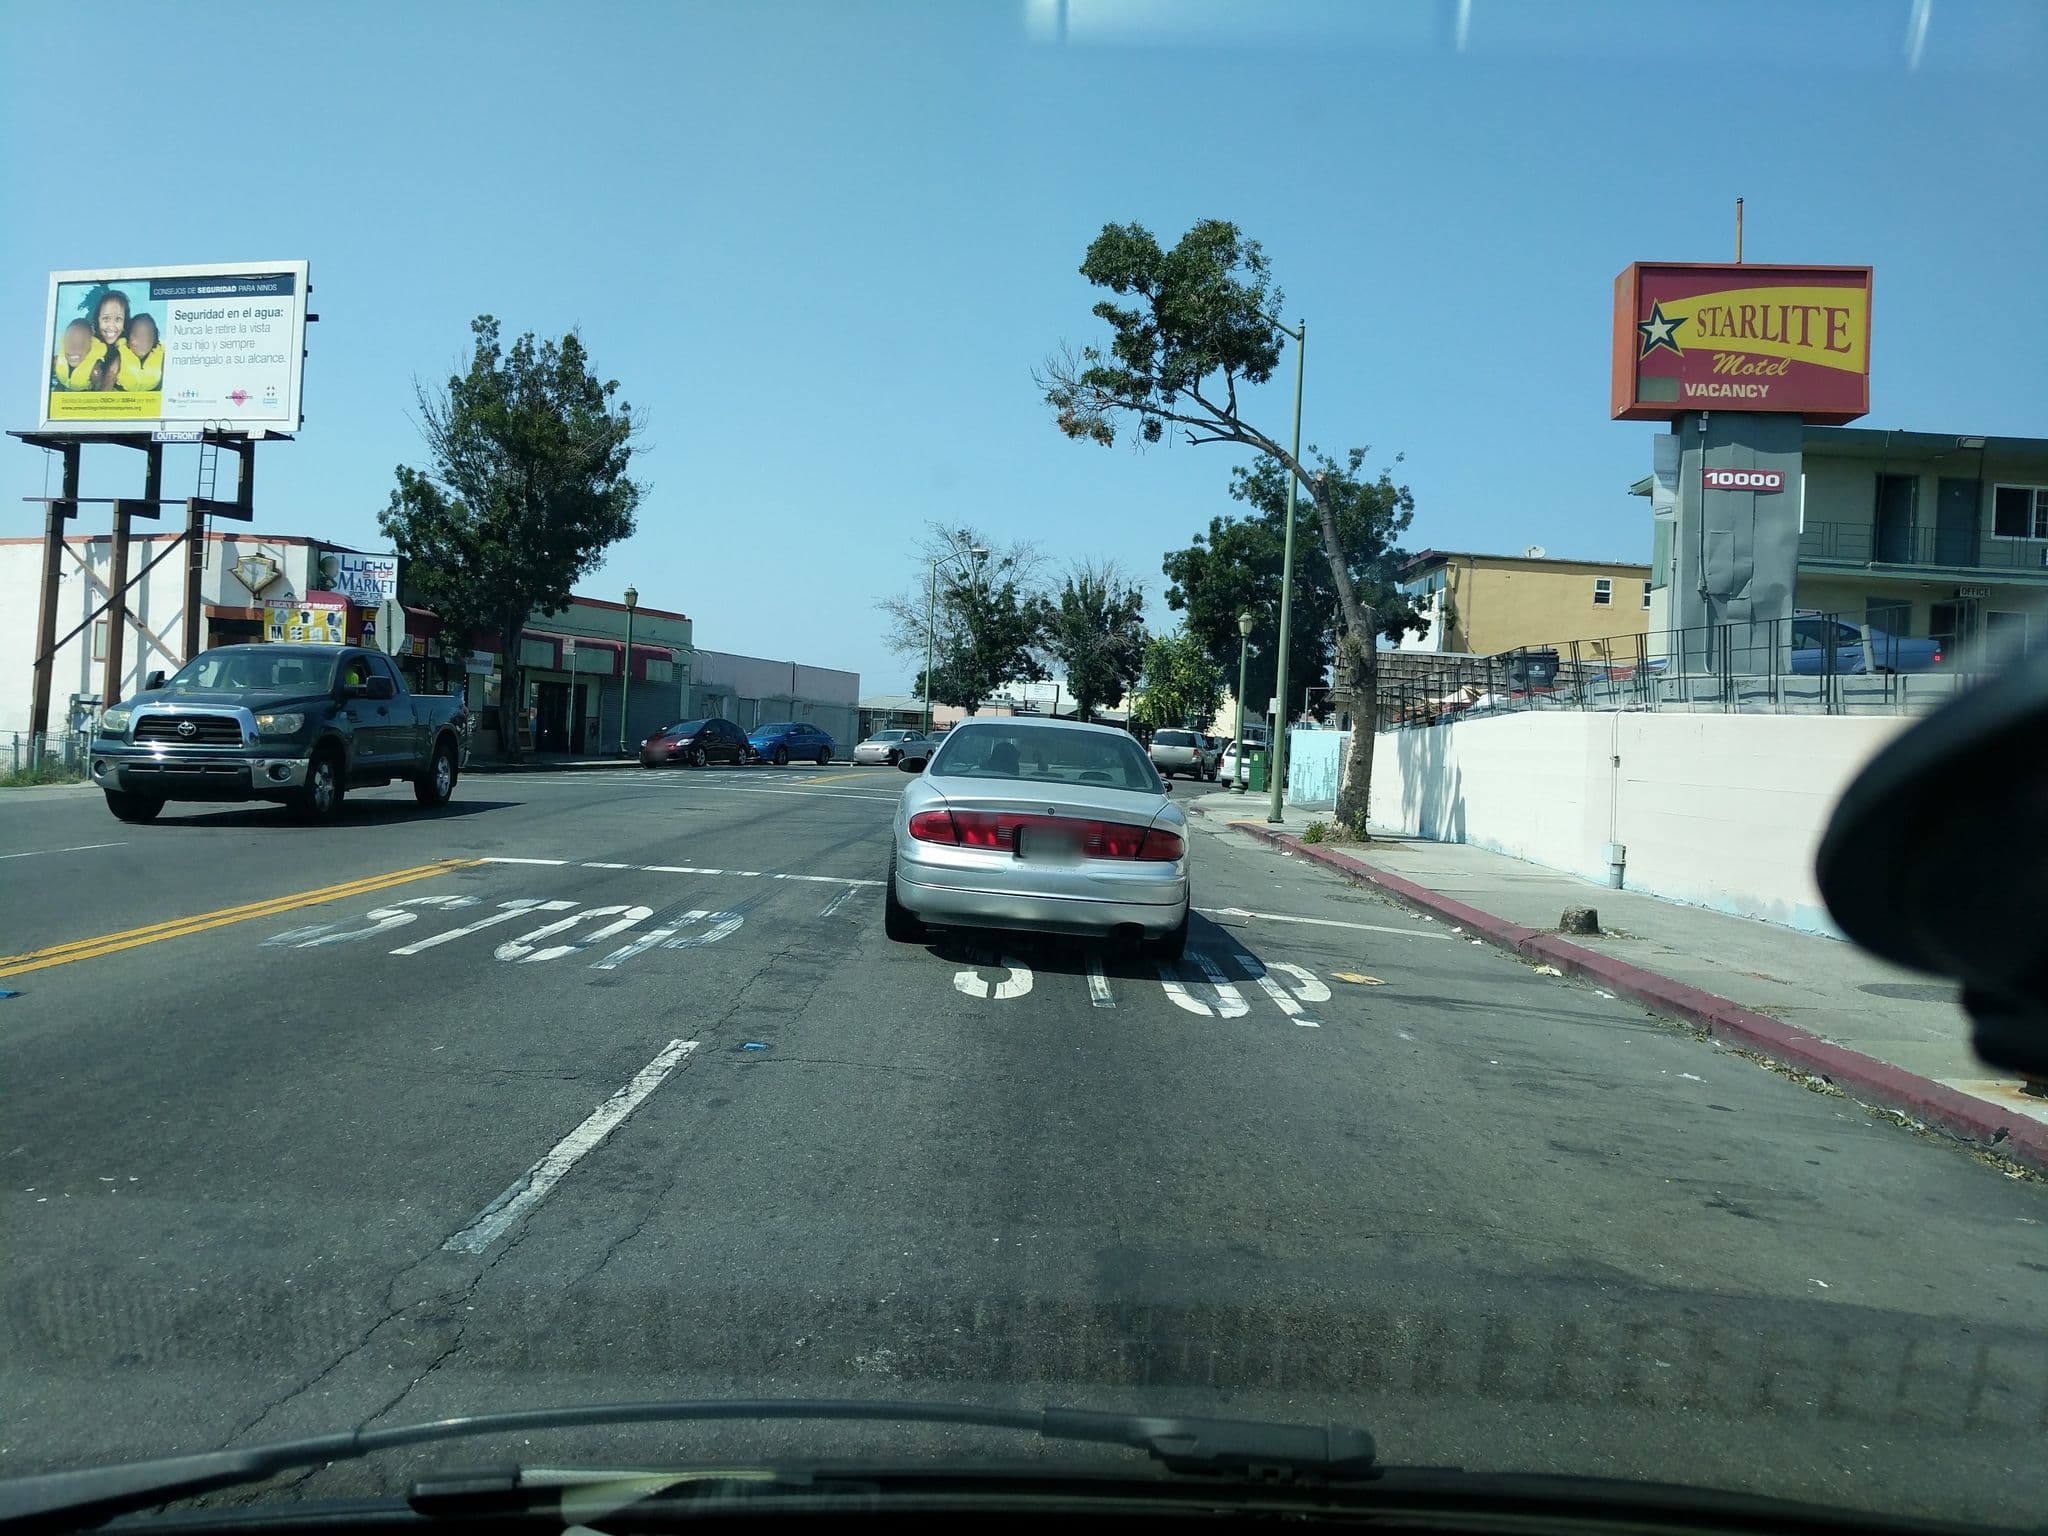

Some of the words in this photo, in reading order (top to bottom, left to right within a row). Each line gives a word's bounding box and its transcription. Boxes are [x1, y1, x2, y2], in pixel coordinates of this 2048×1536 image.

[153, 287, 187, 296] CONSEJOS
[187, 287, 197, 295] DE
[197, 285, 237, 294] SEGURIDAD
[238, 284, 256, 293] PARA
[174, 308, 225, 323] Seguridad
[227, 310, 240, 319] en
[242, 307, 252, 318] el
[254, 308, 284, 320] agua:
[173, 324, 203, 336] Nunca
[205, 323, 213, 335] le
[215, 324, 237, 334] retire
[239, 323, 247, 333] la
[249, 322, 271, 333] vista
[1696, 304, 1853, 354] STARLITE
[172, 342, 179, 350] a
[181, 341, 193, 350] su
[195, 339, 210, 352] hijo
[212, 341, 218, 352] y
[219, 339, 256, 351] siempre
[225, 355, 232, 364] a
[234, 354, 246, 364] su
[1712, 352, 1792, 377] Motel
[1684, 383, 1770, 399] VACANCY
[156, 431, 199, 441] OUTFRONT
[1705, 471, 1781, 488] 10000
[341, 554, 394, 573] LUCKY
[362, 570, 394, 579] STOP
[338, 572, 396, 594] MARKET
[1961, 585, 1991, 599] OFFICE
[269, 600, 293, 609] LUCKY
[256, 895, 745, 970] STOP
